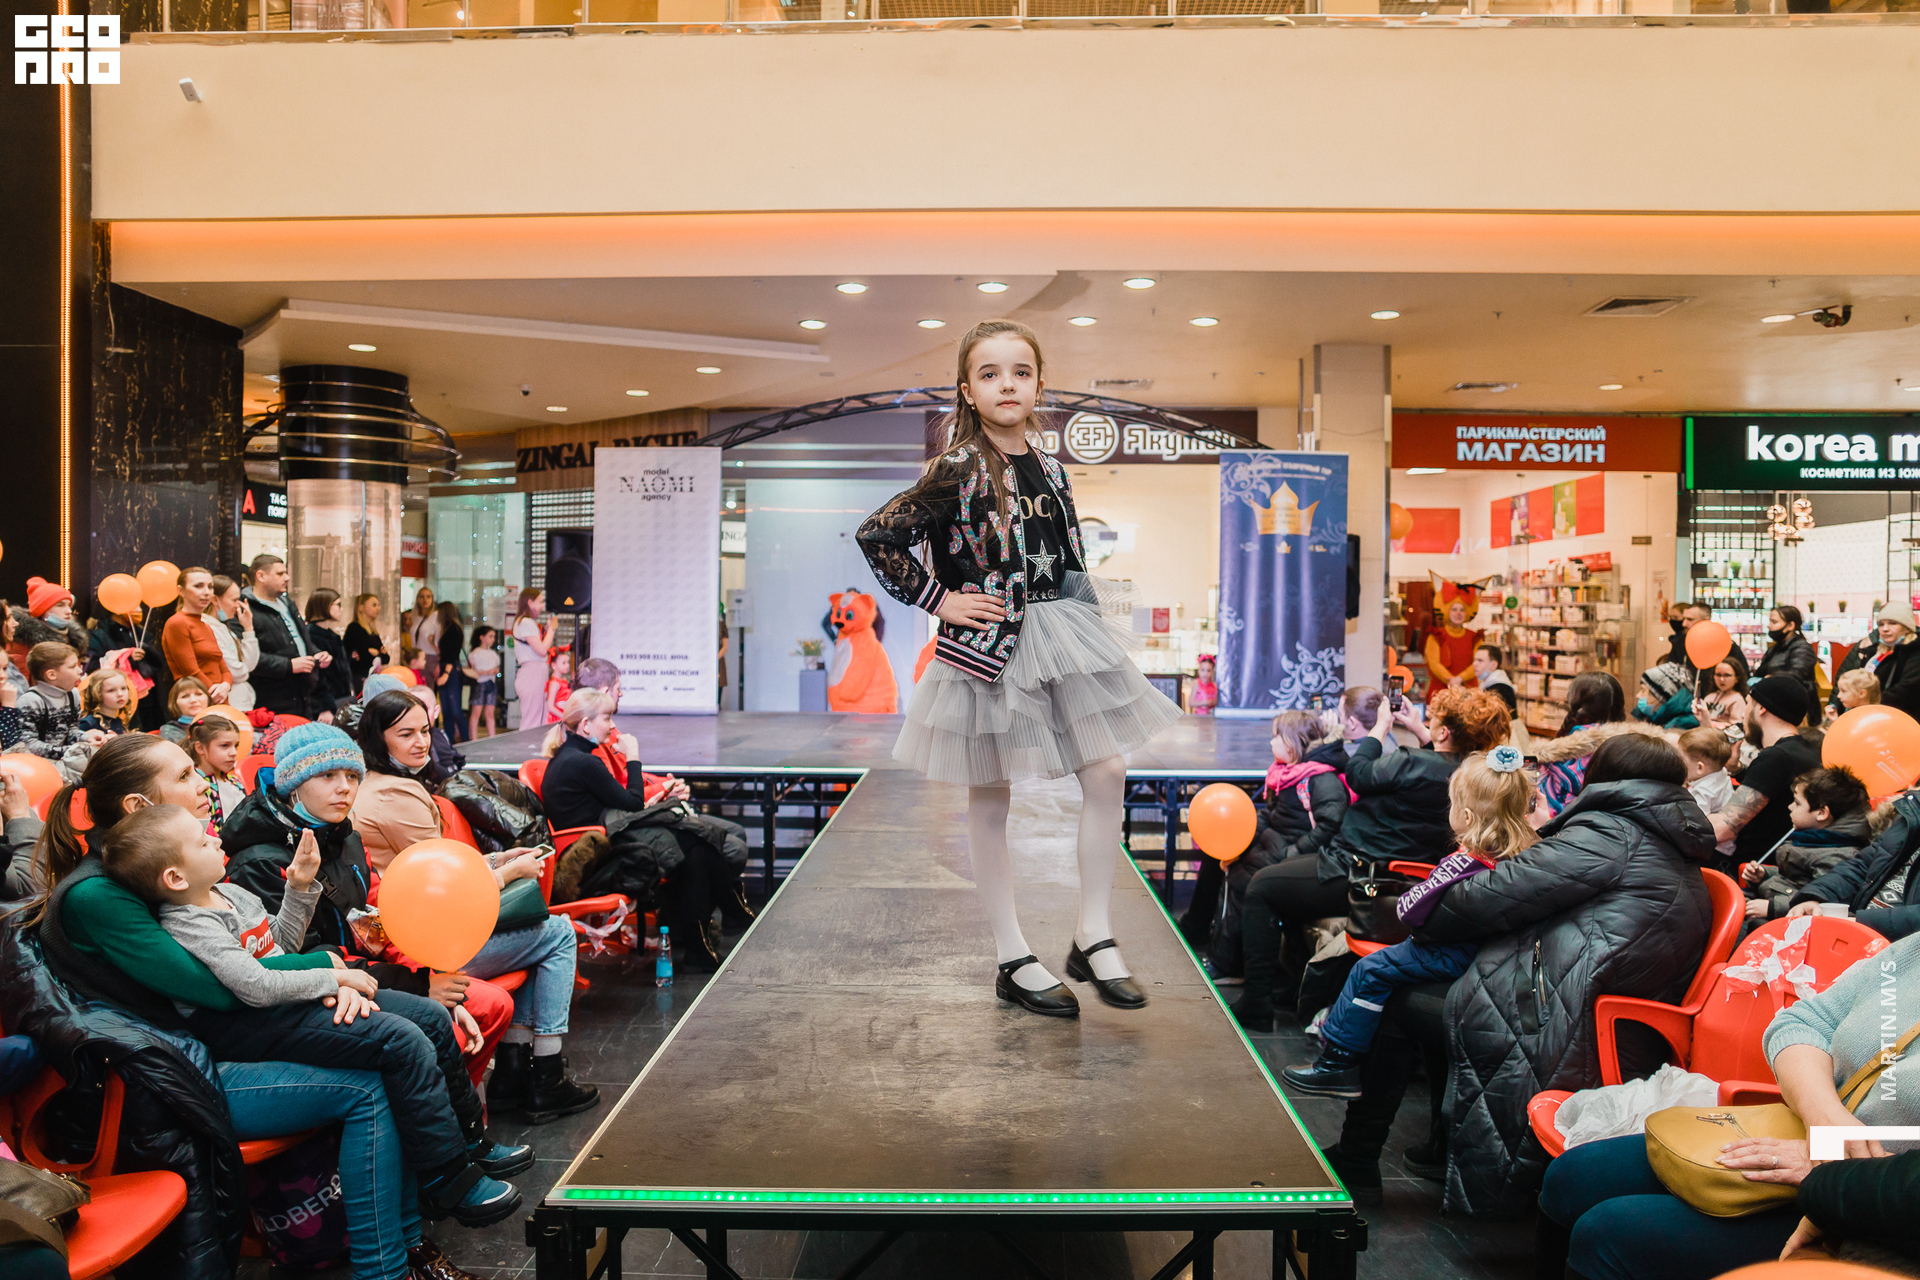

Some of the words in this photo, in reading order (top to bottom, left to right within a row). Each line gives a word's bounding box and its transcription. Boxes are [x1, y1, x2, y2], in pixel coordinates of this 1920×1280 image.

[1456, 425, 1606, 441] ПАРИКМАСТЕРСКИЙ
[1745, 425, 1879, 462] korea
[1457, 442, 1606, 463] МАГАЗИН
[643, 468, 670, 476] model
[1800, 467, 1875, 479] косметика
[1877, 468, 1896, 479] из
[619, 476, 695, 493] NAOMI
[641, 493, 672, 501] agency
